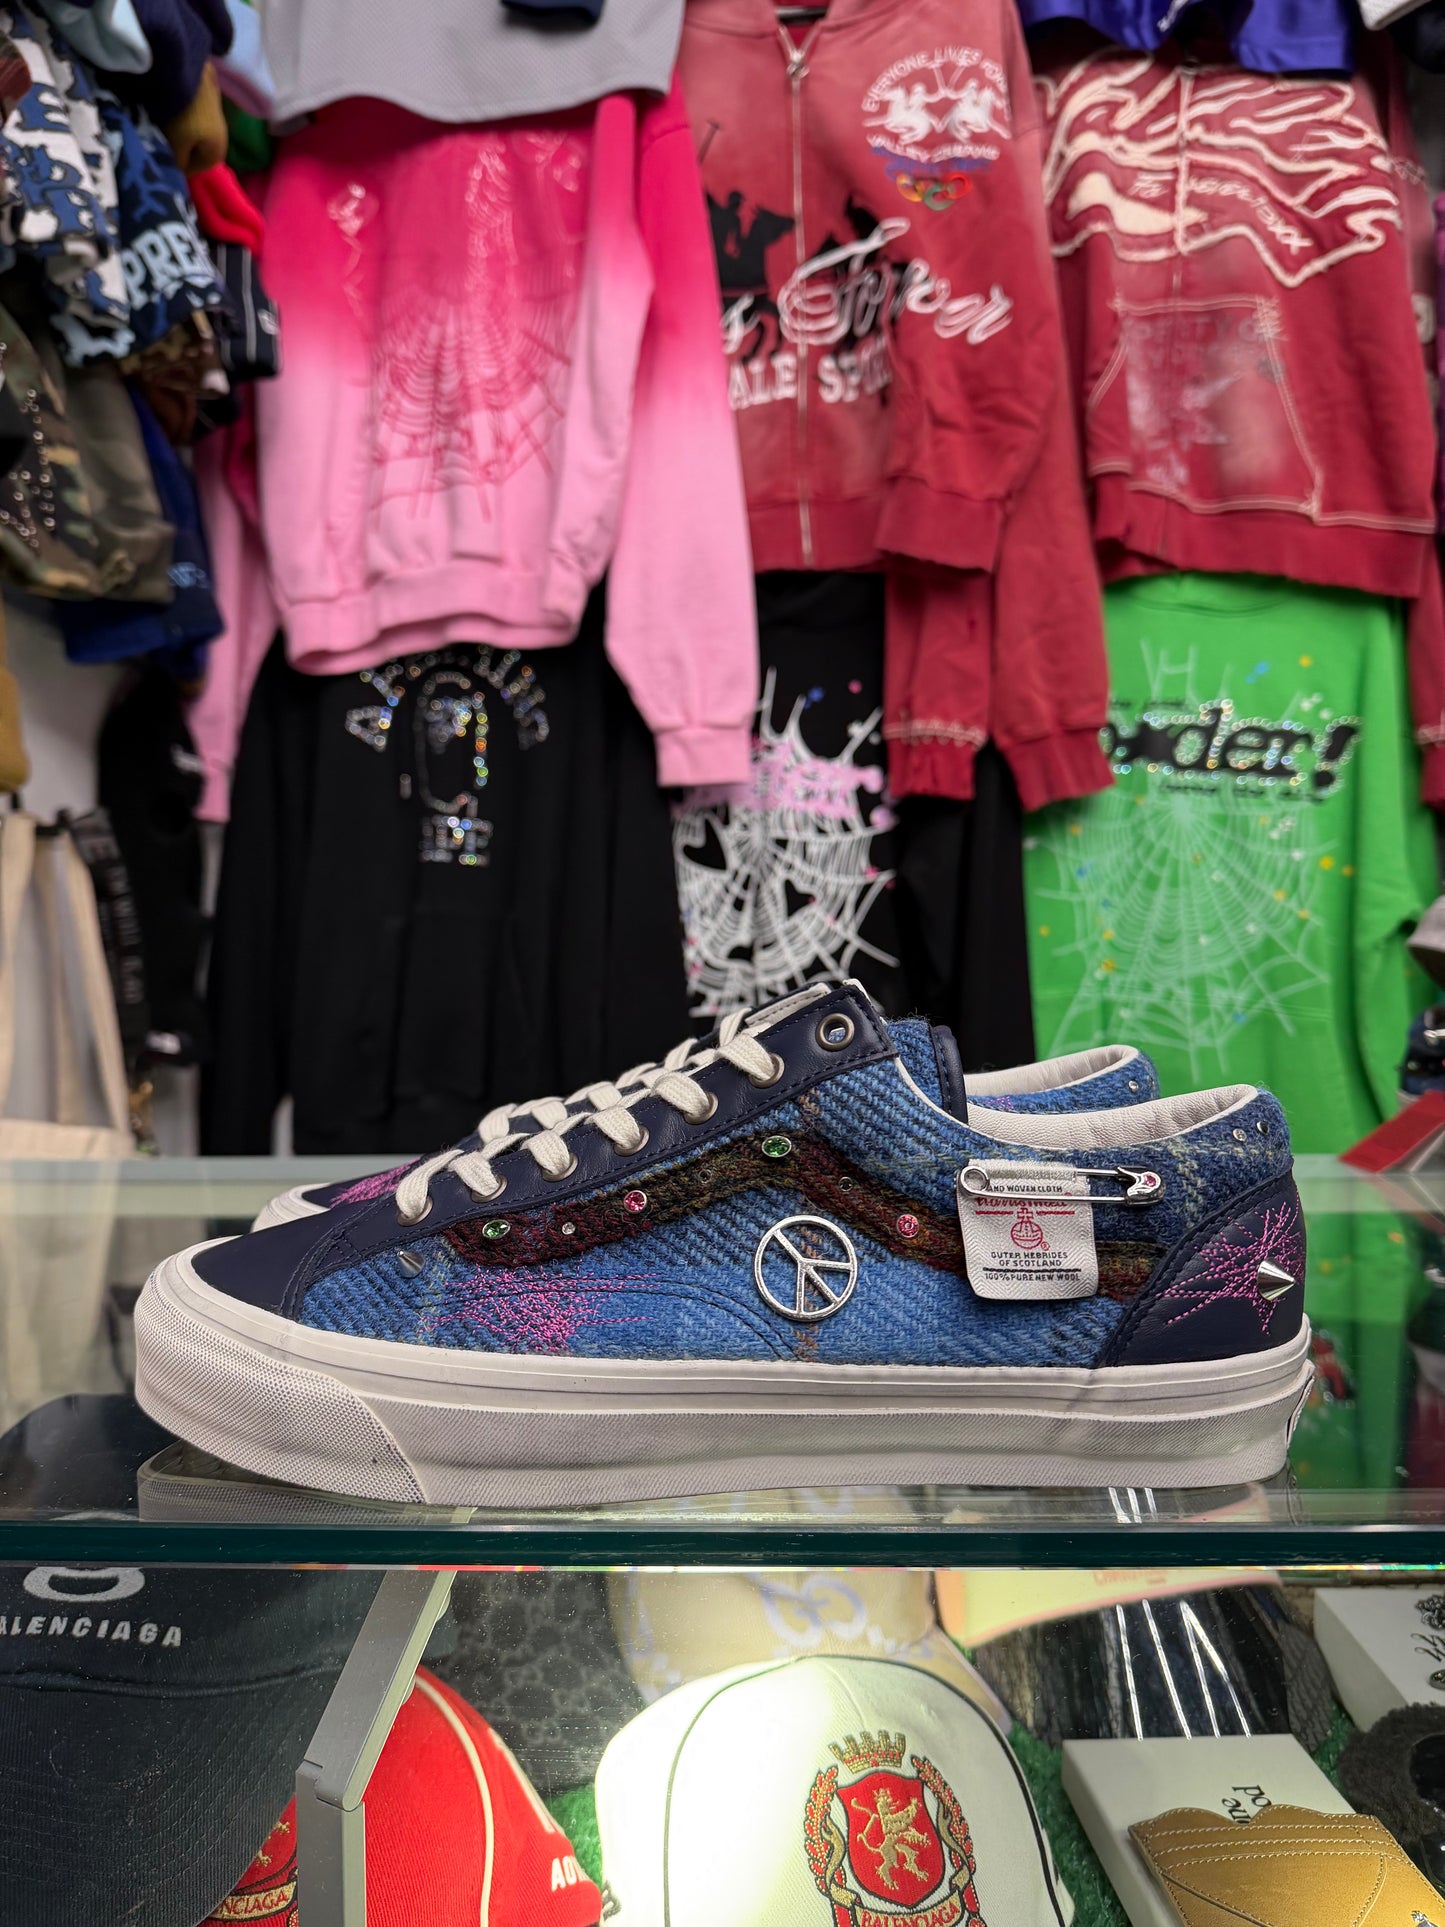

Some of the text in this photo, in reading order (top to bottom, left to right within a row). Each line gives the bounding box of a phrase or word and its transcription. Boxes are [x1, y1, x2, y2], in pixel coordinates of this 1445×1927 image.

[861, 52, 931, 112] EVERYONE
[986, 1185, 1005, 1193] AND
[1038, 1185, 1063, 1193] CLOTH
[991, 1251, 1068, 1259] OUTER HEBRIDES
[999, 1259, 1062, 1267] OF SCOTLAND
[985, 1273, 1080, 1281] 100% PURE NEW WOOL
